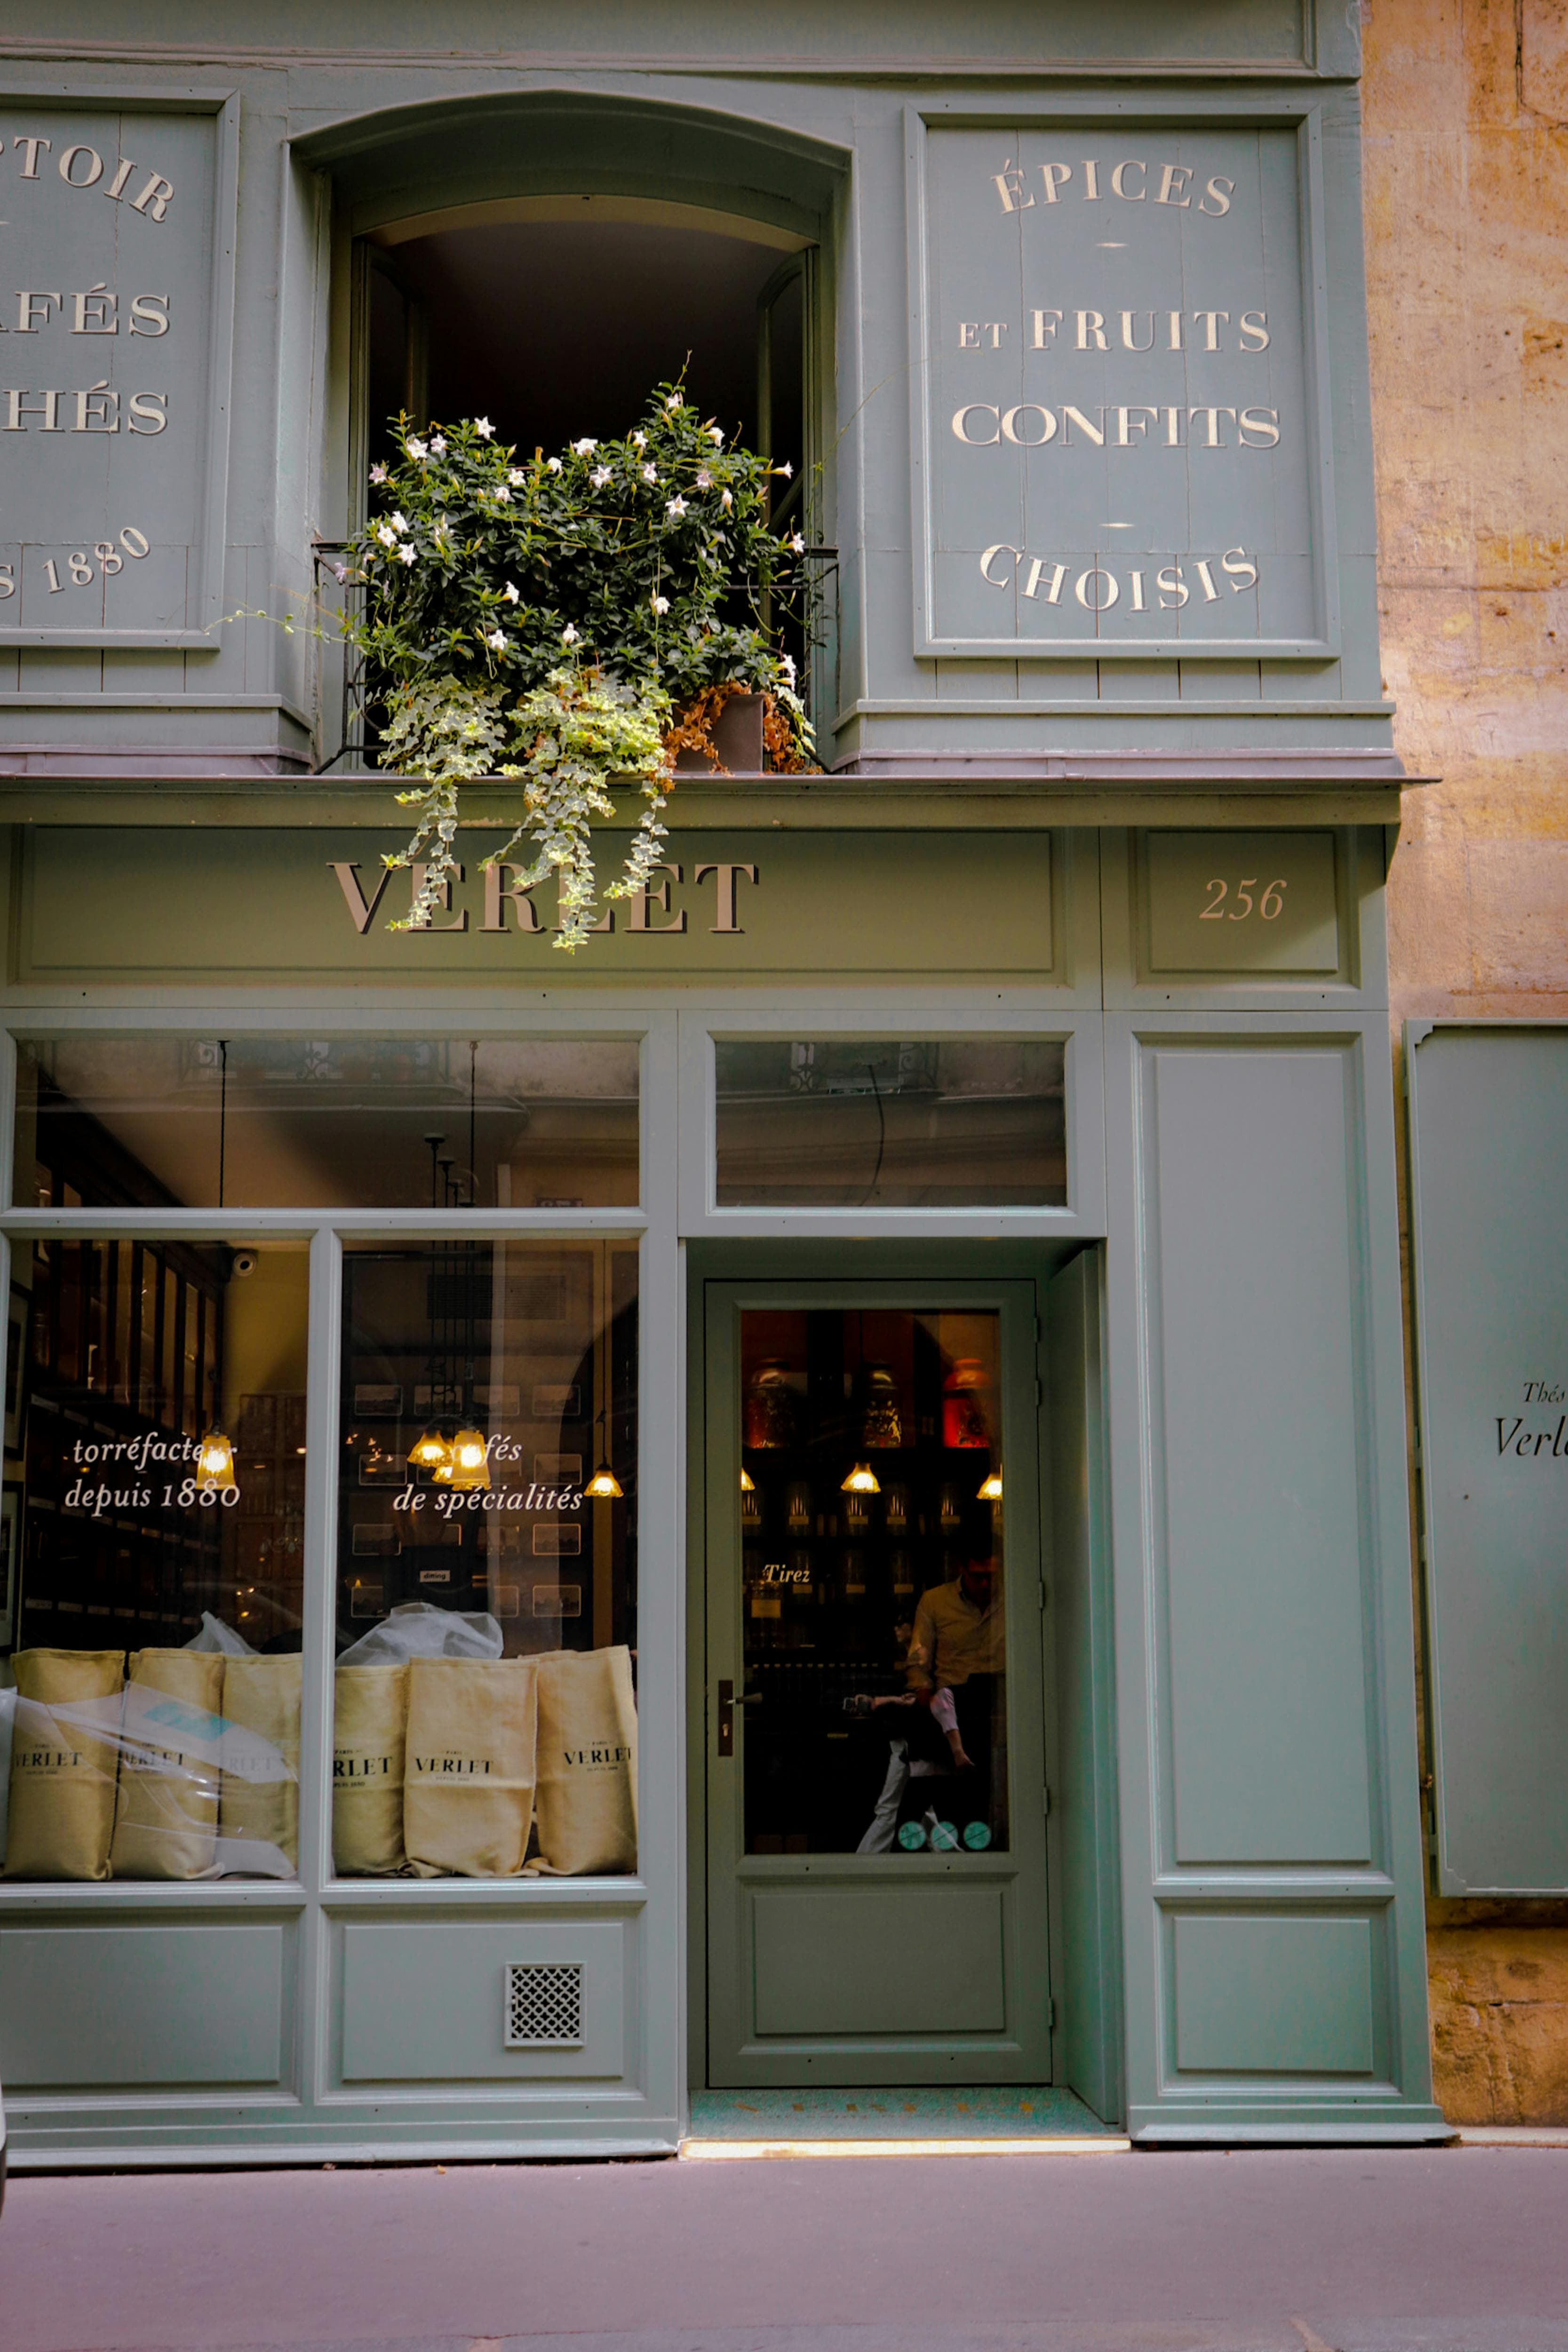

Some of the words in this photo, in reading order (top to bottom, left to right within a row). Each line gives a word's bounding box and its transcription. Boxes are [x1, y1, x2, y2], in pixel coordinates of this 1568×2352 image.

[0, 135, 175, 223] TOIR
[990, 159, 1236, 218] ÉPICES
[0, 283, 170, 337] FÉS
[958, 322, 1009, 349] ET
[1030, 309, 1272, 352] FRUITS
[951, 404, 1281, 449] CONFITS
[42, 527, 151, 594] 1880
[979, 543, 1260, 612] CHOISIS
[326, 862, 759, 934] VERLET
[1199, 878, 1288, 920] 256
[1523, 1381, 1566, 1403] Thés
[1493, 1415, 1568, 1457] Verl
[64, 1479, 151, 1518] depuis
[160, 1478, 241, 1507] 1880
[393, 1483, 425, 1510] de
[434, 1483, 583, 1518] spécialités
[764, 1564, 810, 1583] Tirez
[416, 1757, 494, 1774] VERLET
[564, 1747, 632, 1765] VERLET
